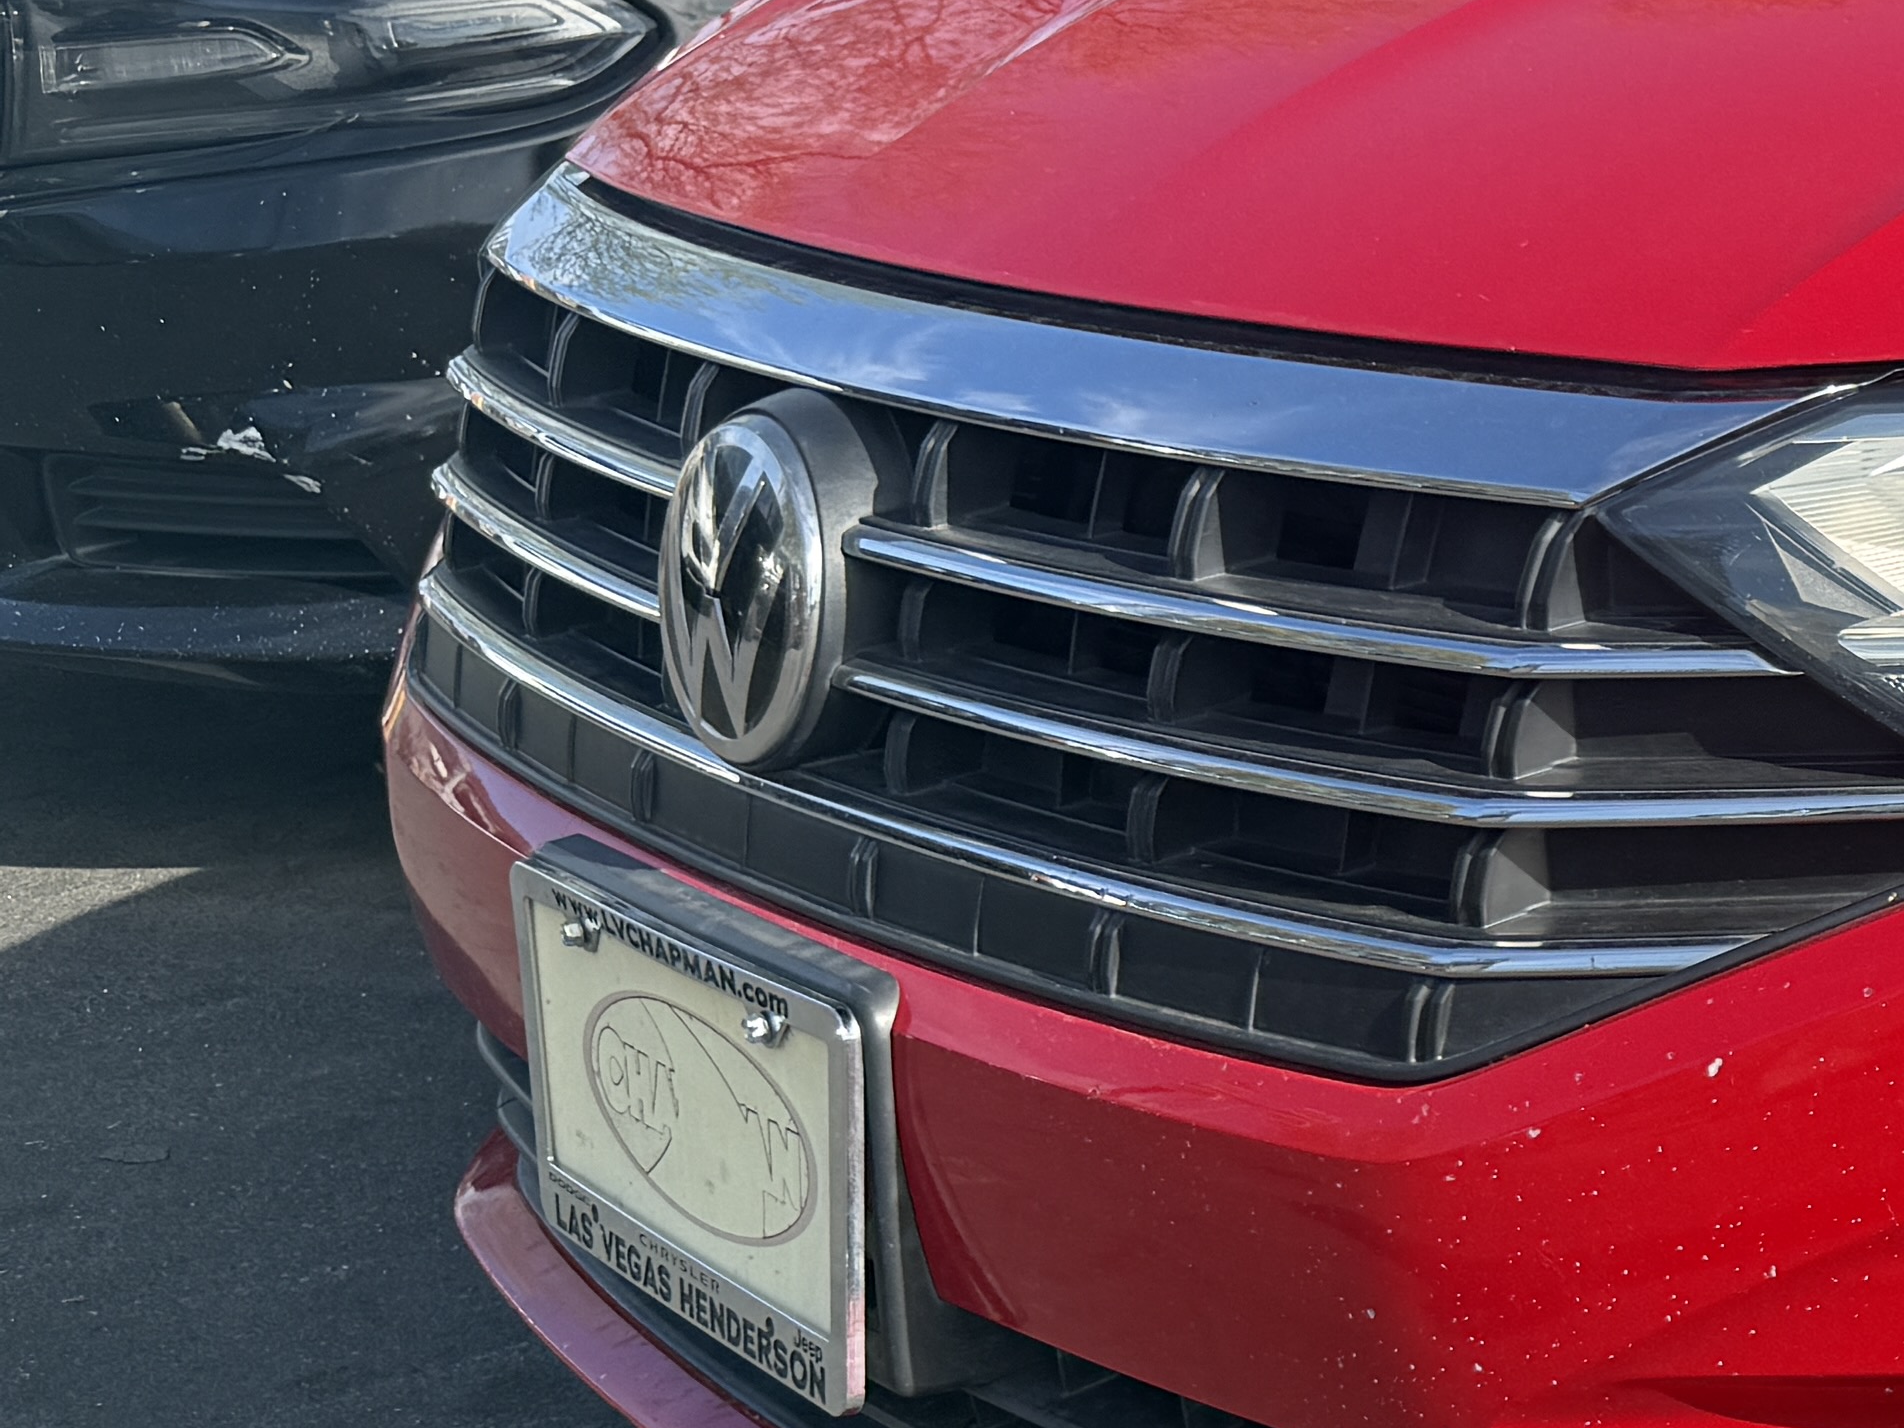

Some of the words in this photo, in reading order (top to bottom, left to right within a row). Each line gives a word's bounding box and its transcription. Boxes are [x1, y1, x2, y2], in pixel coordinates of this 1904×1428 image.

[638, 1232, 721, 1295] CHRYSLER
[554, 1191, 595, 1250] LAS
[599, 1223, 672, 1304] VEGAS
[678, 1275, 828, 1406] HENDERSON
[792, 1327, 823, 1365] Jeep
